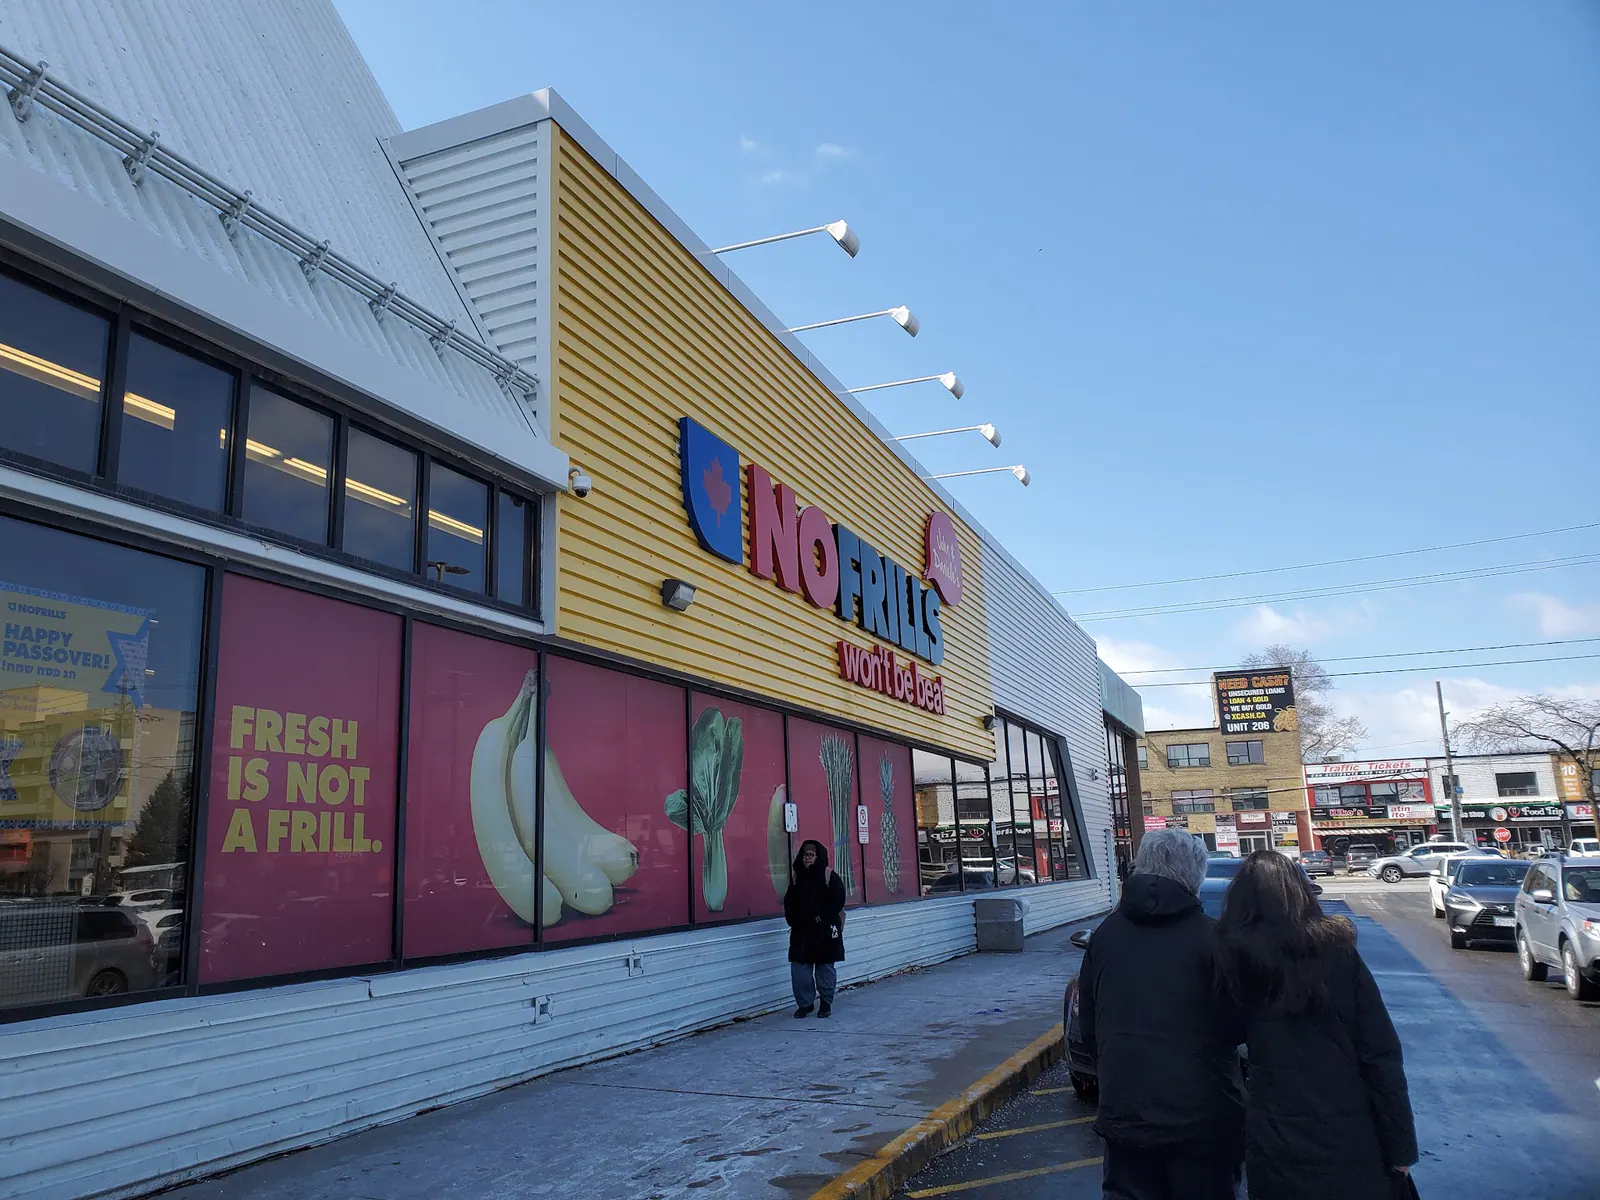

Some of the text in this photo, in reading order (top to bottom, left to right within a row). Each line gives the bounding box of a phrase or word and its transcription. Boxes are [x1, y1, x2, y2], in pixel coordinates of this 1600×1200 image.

[18, 603, 67, 619] NOFRILLS
[4, 623, 73, 647] HAPPY
[3, 640, 110, 670] PASSOVER!
[837, 641, 948, 715] won't be beat
[1217, 674, 1289, 690] NEED CASH?
[1228, 689, 1264, 698] UNSECURED
[1231, 712, 1266, 720] XCASH.CA
[229, 705, 359, 760] FRESH
[1227, 721, 1270, 732] UNIT 206
[1323, 760, 1411, 772] Traffic Tickets
[227, 756, 371, 807] IS NOT
[1329, 808, 1363, 817] Kiko's
[1521, 806, 1564, 817] Food Trip
[221, 808, 383, 854] A FRILL.
[1494, 831, 1509, 839] STOP
